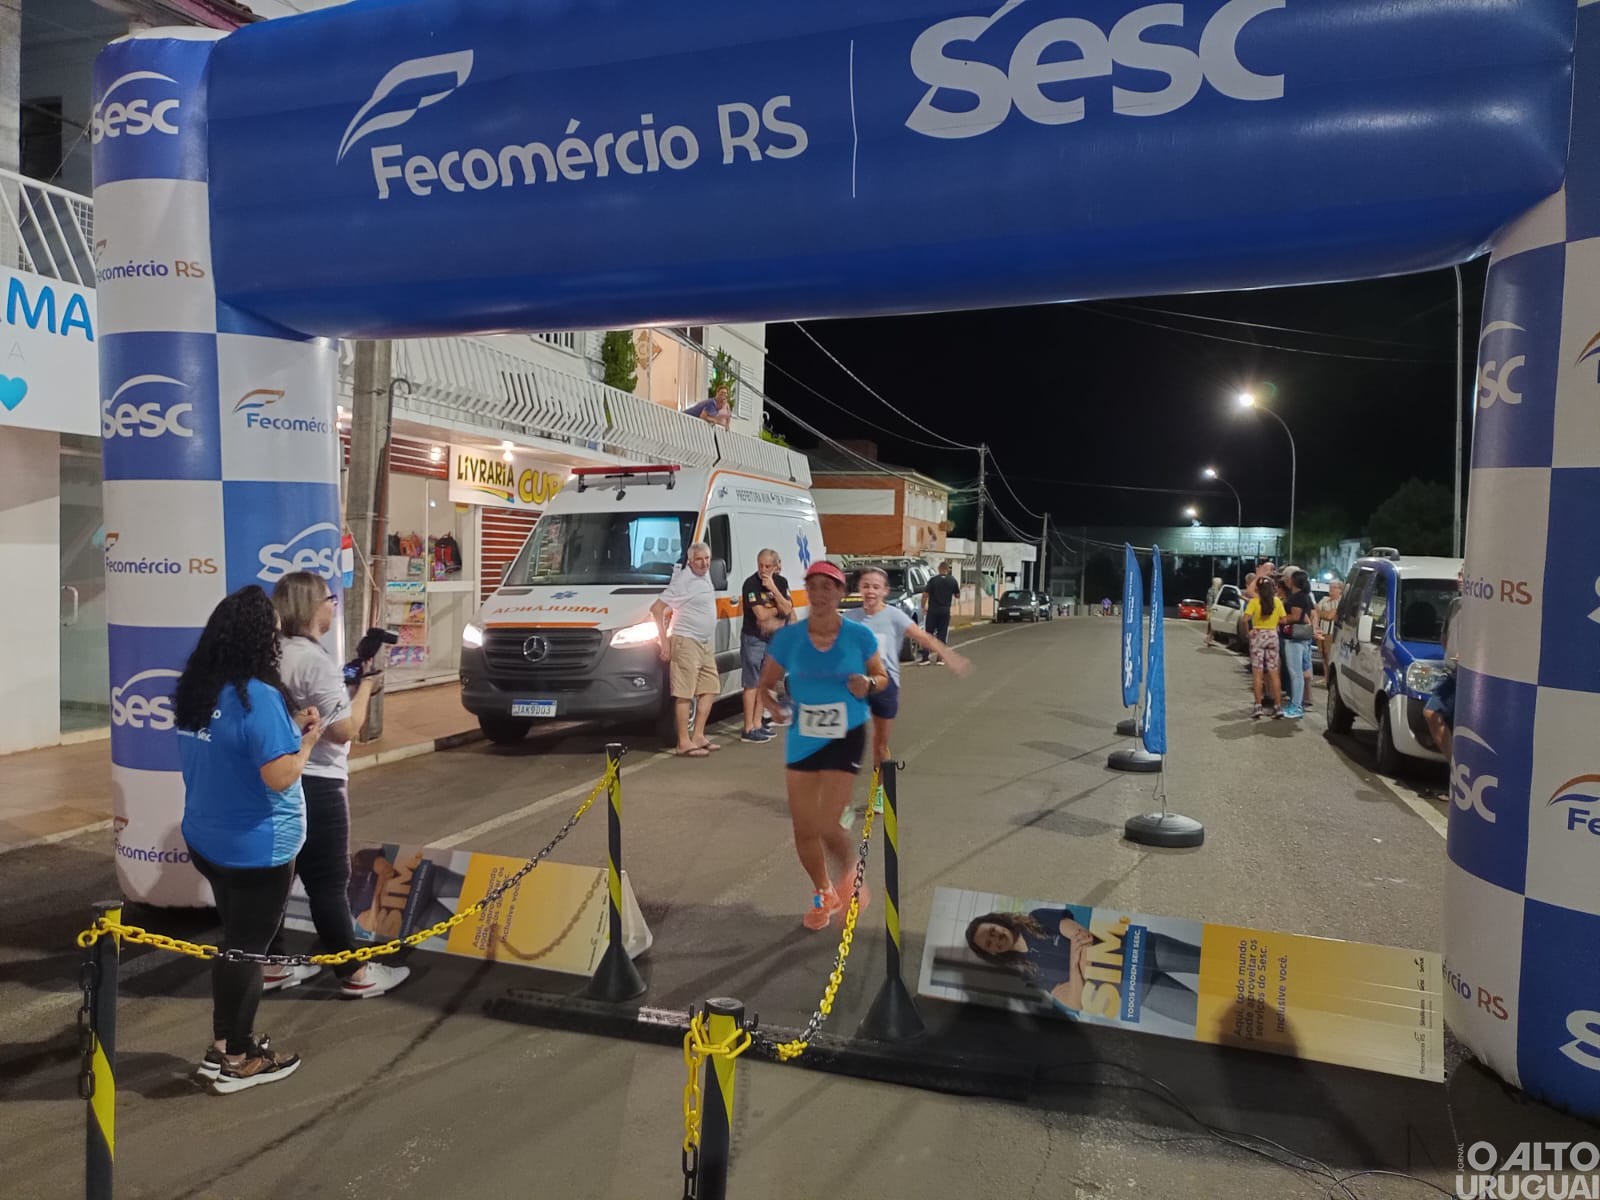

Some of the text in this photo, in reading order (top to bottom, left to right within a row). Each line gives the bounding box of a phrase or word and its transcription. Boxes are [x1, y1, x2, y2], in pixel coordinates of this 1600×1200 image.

[905, 0, 1287, 138] Sesc
[92, 99, 180, 145] Sesc
[371, 95, 809, 199] Fecomércio RS
[96, 260, 206, 281] comércio RS
[0, 277, 95, 342] MA
[1478, 355, 1526, 409] sc
[102, 400, 193, 439] Sesc
[188, 558, 218, 575] RS
[1500, 579, 1533, 606] RS
[111, 686, 177, 731] Ses
[802, 708, 841, 728] 722
[1131, 950, 1140, 964] SER
[1238, 939, 1248, 975] mundo
[1250, 938, 1258, 951] os
[1129, 965, 1138, 991] PODEM
[1235, 978, 1246, 1004] todo
[1247, 954, 1257, 1008] aproveitar
[1256, 974, 1266, 989] do
[1127, 992, 1136, 1018] TODOS
[1477, 986, 1509, 1021] RS
